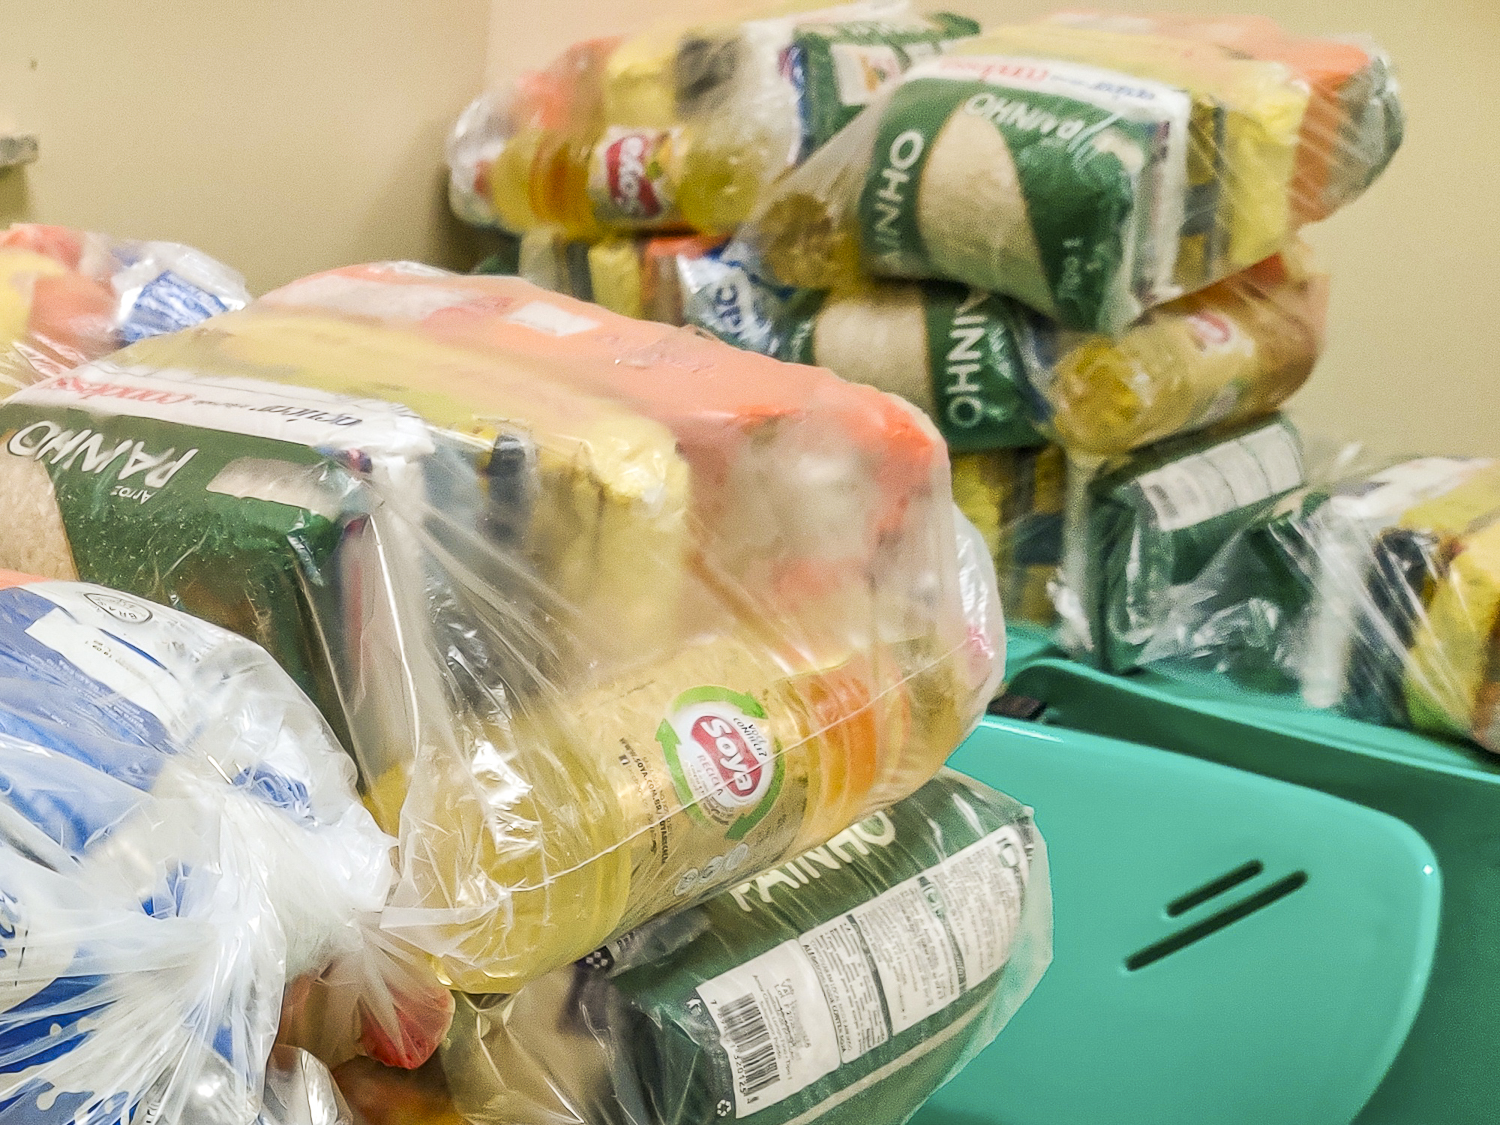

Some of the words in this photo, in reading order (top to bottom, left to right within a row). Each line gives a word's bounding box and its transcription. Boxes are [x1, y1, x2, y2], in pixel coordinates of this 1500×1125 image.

[5, 420, 200, 490] PAINHO
[109, 484, 156, 505] Arroz
[698, 713, 761, 794] Soya
